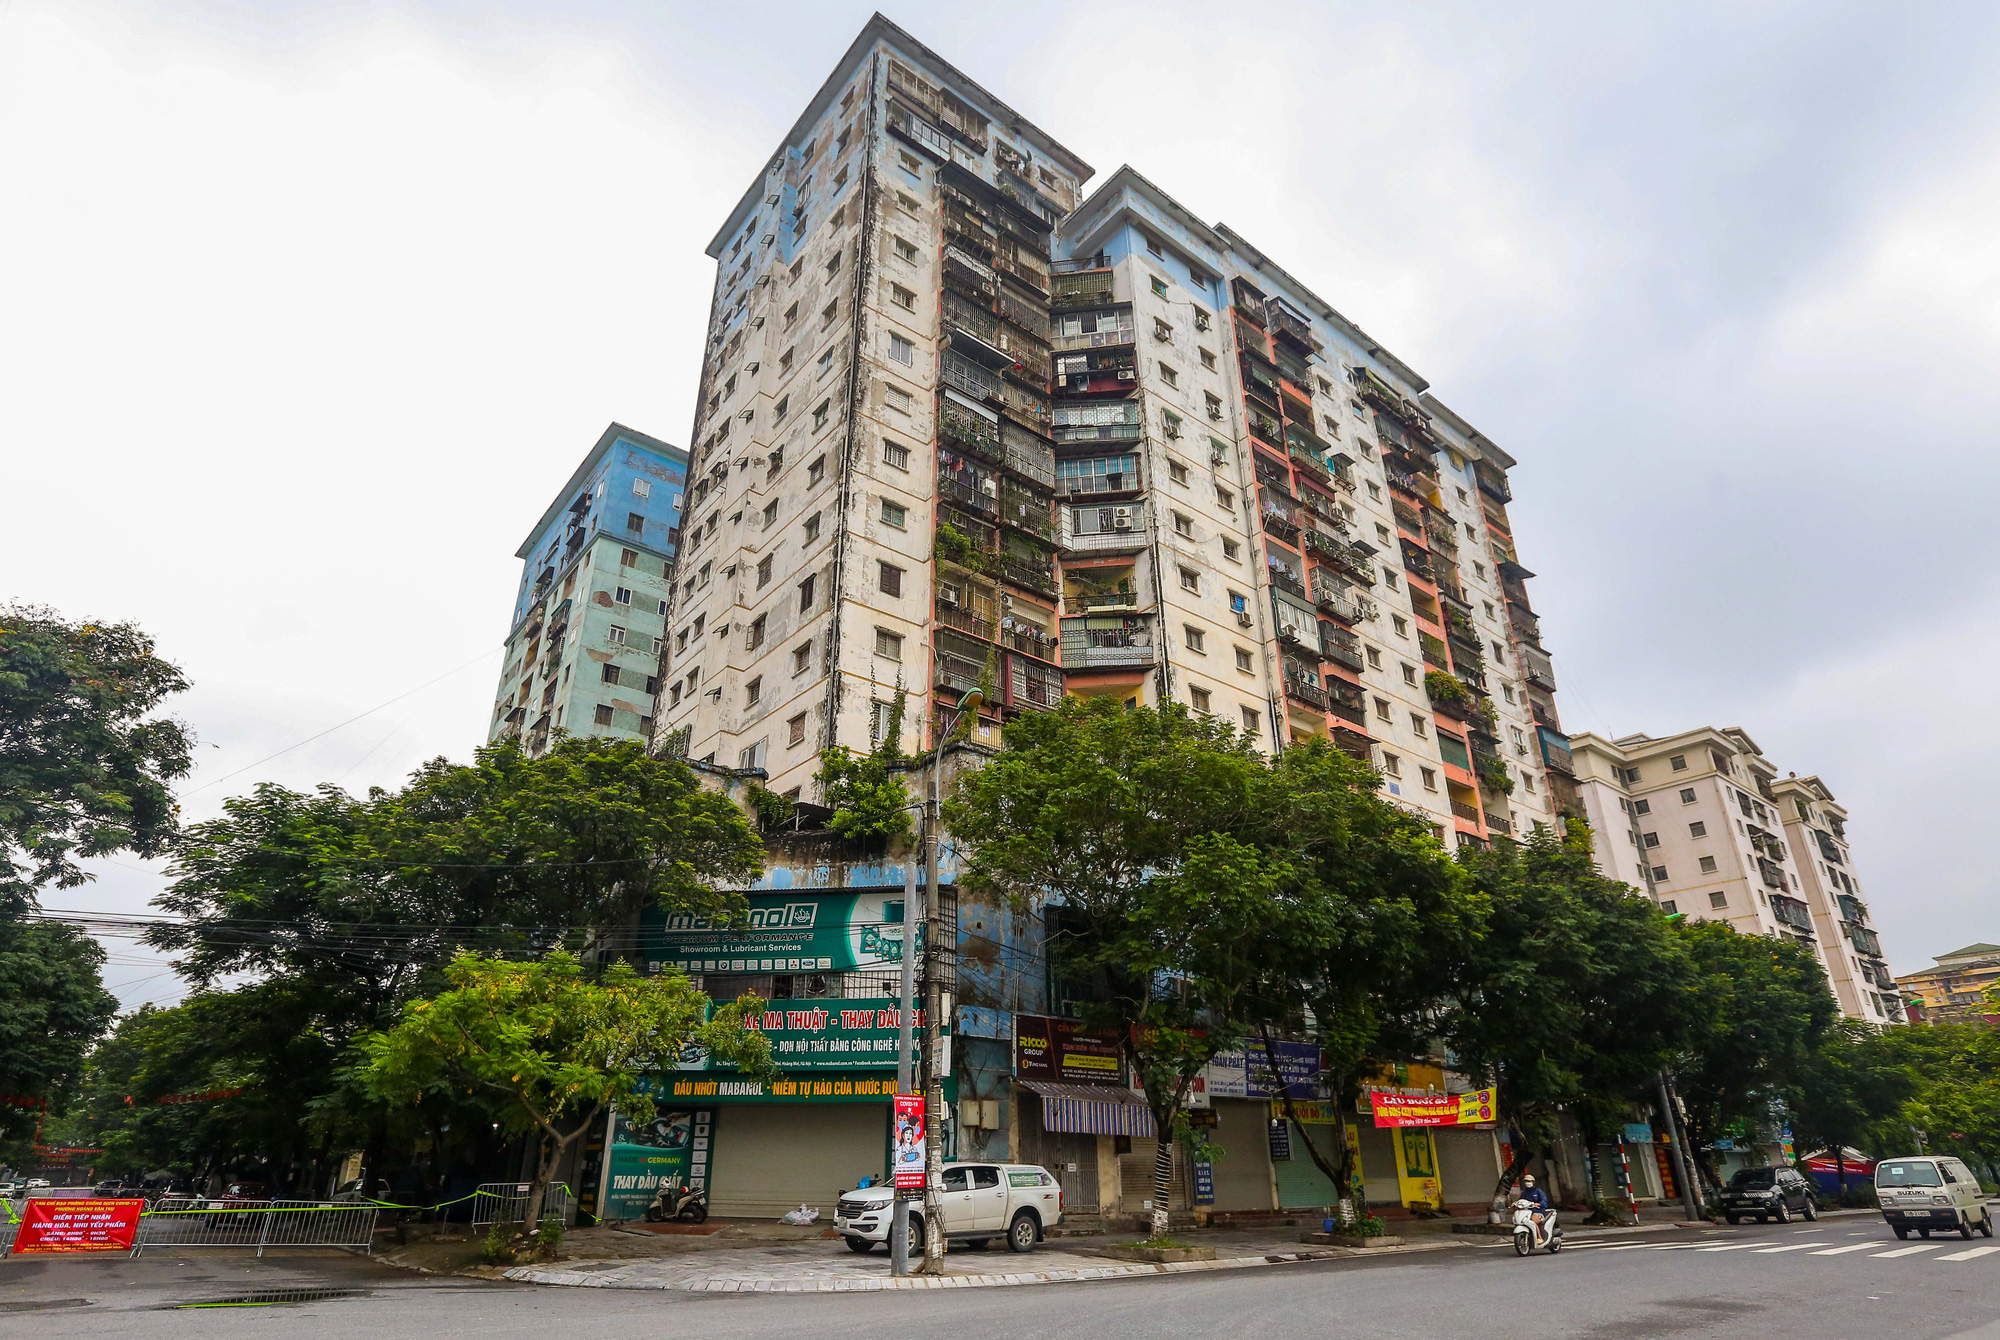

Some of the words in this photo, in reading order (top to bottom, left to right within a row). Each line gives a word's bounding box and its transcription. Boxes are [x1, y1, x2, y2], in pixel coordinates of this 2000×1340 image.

[722, 933, 814, 943] PERFORMANCE
[680, 945, 721, 954] Showroom
[722, 945, 728, 953] &
[730, 944, 767, 953] Lubricant
[768, 943, 802, 952] Services
[763, 1010, 784, 1030] MA
[787, 1006, 829, 1034] THUẬT
[841, 1009, 875, 1030] THAY
[851, 1038, 872, 1052] CÔNG
[873, 1037, 893, 1054] NGHỆ
[1023, 1048, 1044, 1056] GROUP
[1228, 1054, 1244, 1069] PHÁT
[694, 1078, 718, 1096] NHỚT
[719, 1081, 763, 1096] MABANOL
[800, 1080, 812, 1098] TỰ
[813, 1078, 832, 1095] HÀO
[834, 1076, 852, 1095] CỦA
[854, 1077, 880, 1095] NƯỚC
[1480, 1091, 1488, 1100] 5
[1320, 1104, 1333, 1119] 79
[1482, 1107, 1489, 1118] 1
[647, 1156, 681, 1164] GERMANY
[613, 1175, 639, 1190] THAY
[637, 1169, 658, 1190] DẦU
[53, 1212, 73, 1221] ĐIỂM
[73, 1212, 90, 1221] TIẾP
[90, 1213, 112, 1221] NHẬN
[32, 1221, 53, 1229] HÀNG
[90, 1220, 104, 1229] YẾU
[104, 1219, 126, 1229] PHẨM
